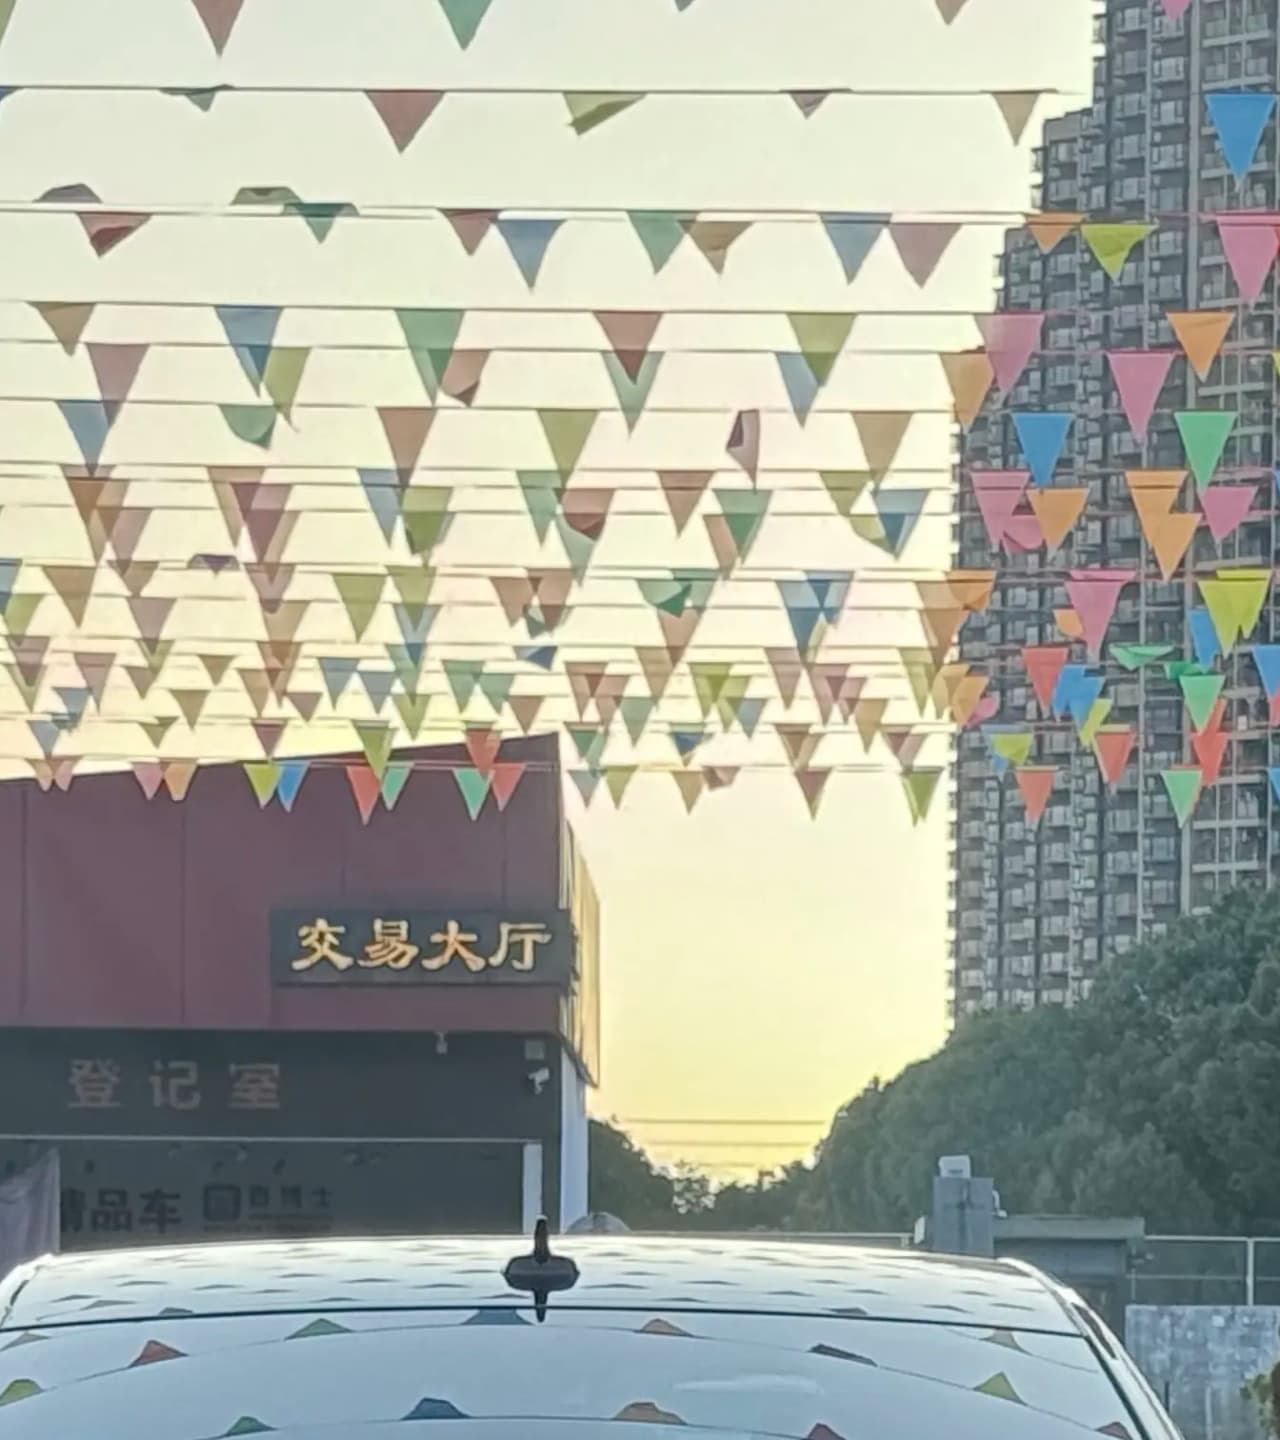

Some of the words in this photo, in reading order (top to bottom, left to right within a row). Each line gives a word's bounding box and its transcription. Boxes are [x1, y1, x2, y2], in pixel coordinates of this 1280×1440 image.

[292, 918, 552, 972] 交易大厅
[68, 1058, 281, 1110] 登记室
